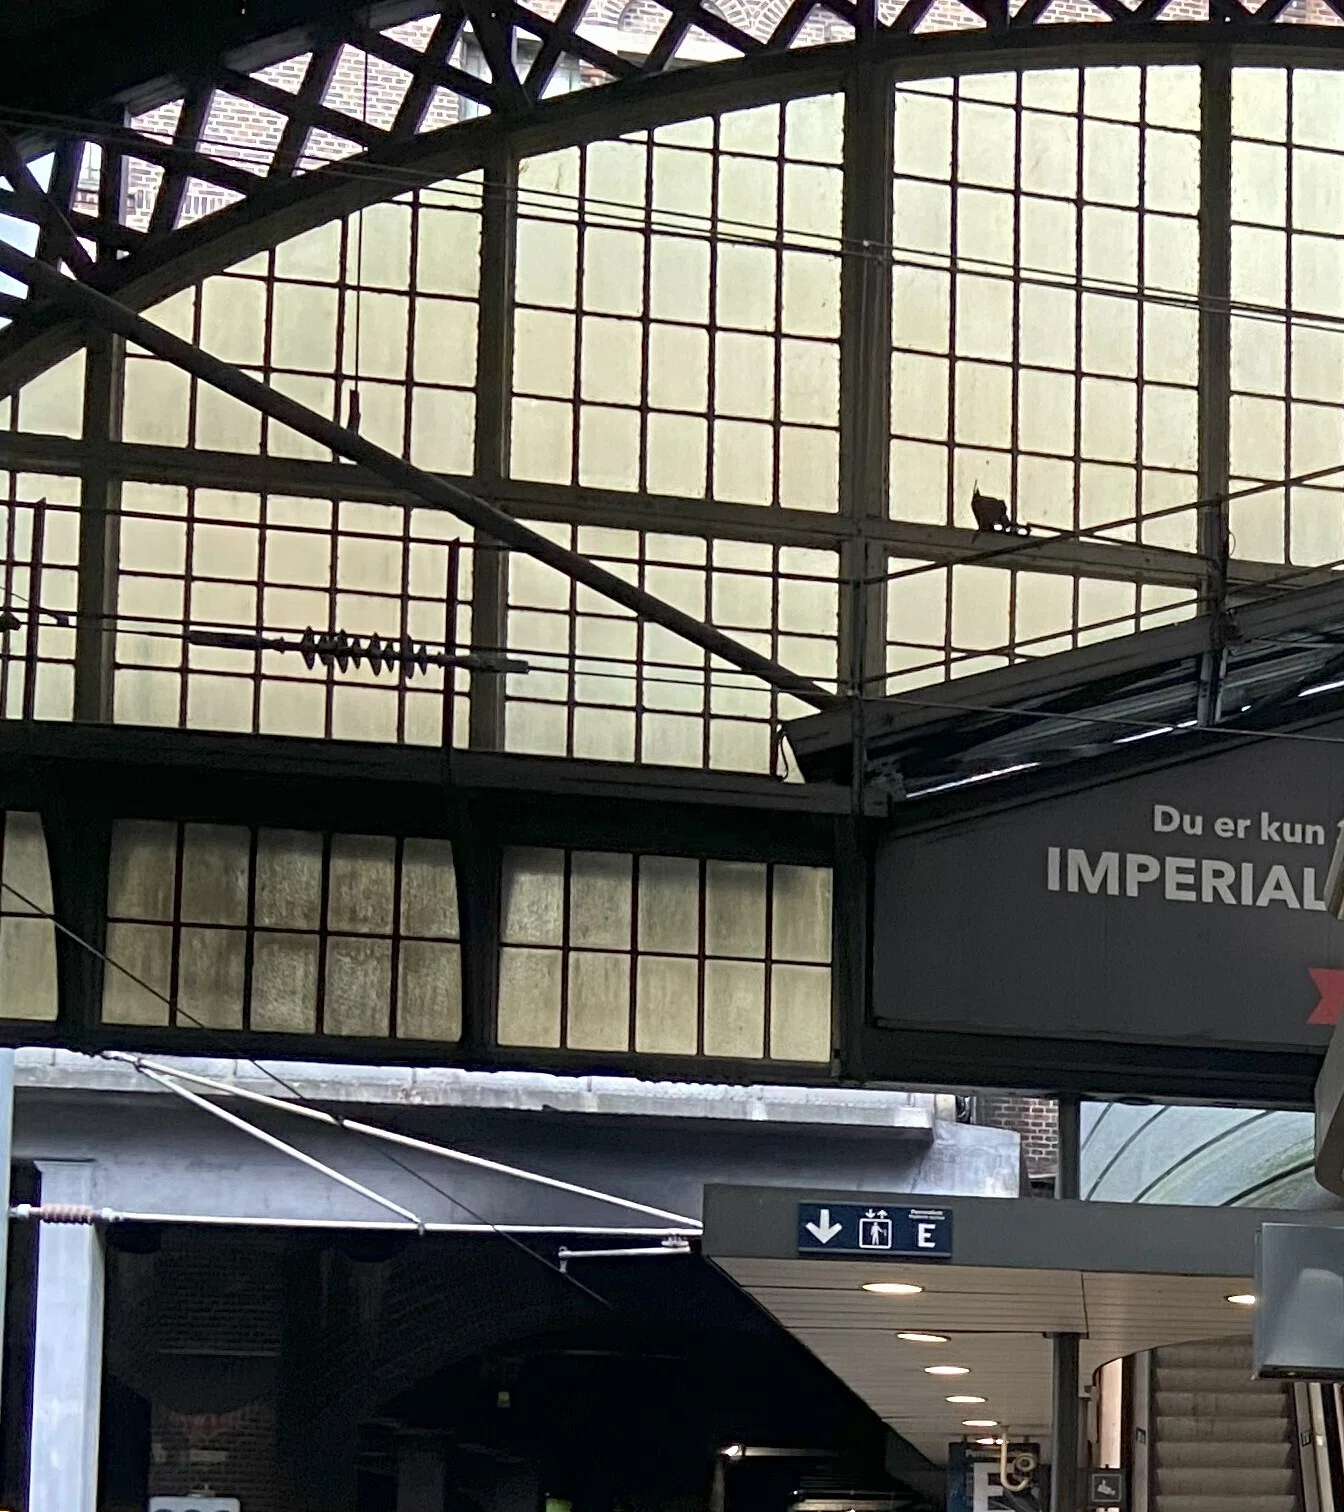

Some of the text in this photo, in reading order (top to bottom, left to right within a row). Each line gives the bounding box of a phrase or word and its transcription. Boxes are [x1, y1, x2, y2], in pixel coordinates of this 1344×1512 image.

[1153, 804, 1203, 836] Du
[1213, 815, 1251, 840] er
[1260, 811, 1325, 845] kun
[1047, 846, 1328, 911] IMPERIAL
[917, 1223, 936, 1248] E
